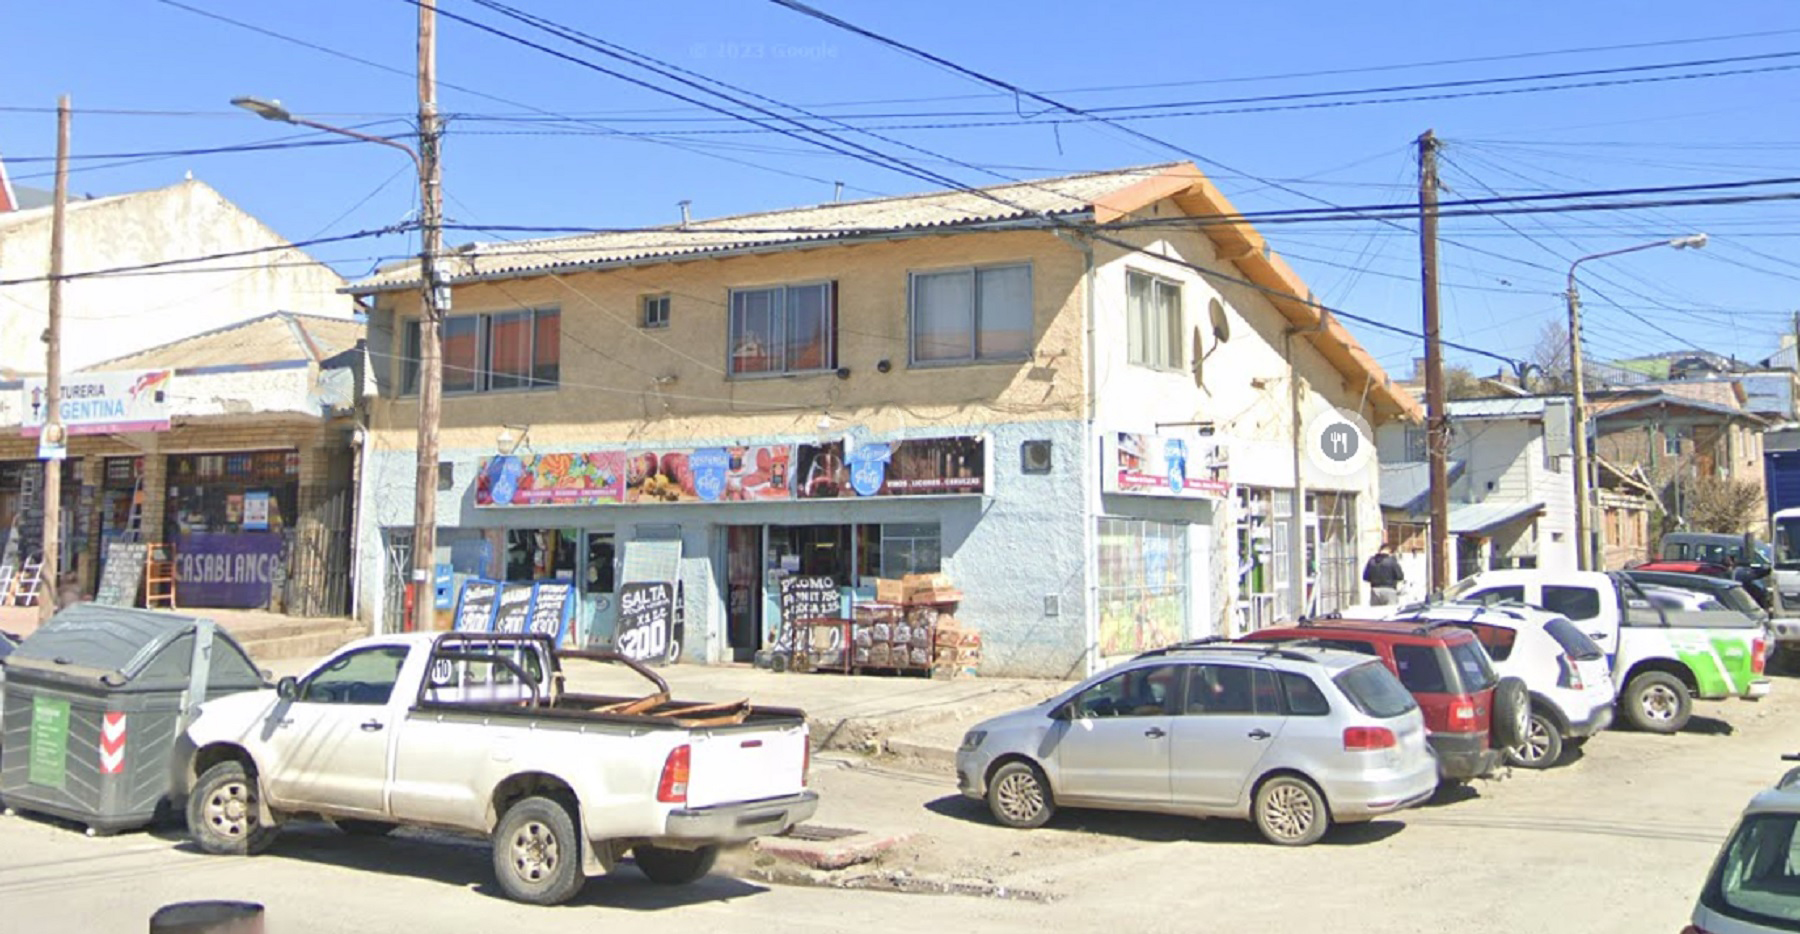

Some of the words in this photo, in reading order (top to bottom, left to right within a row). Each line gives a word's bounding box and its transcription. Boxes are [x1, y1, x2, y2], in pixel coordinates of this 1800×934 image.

[40, 401, 124, 420] AGENTINA
[176, 553, 282, 584] CASABLANCA
[622, 585, 667, 609] SALTA
[618, 618, 666, 661] $200
